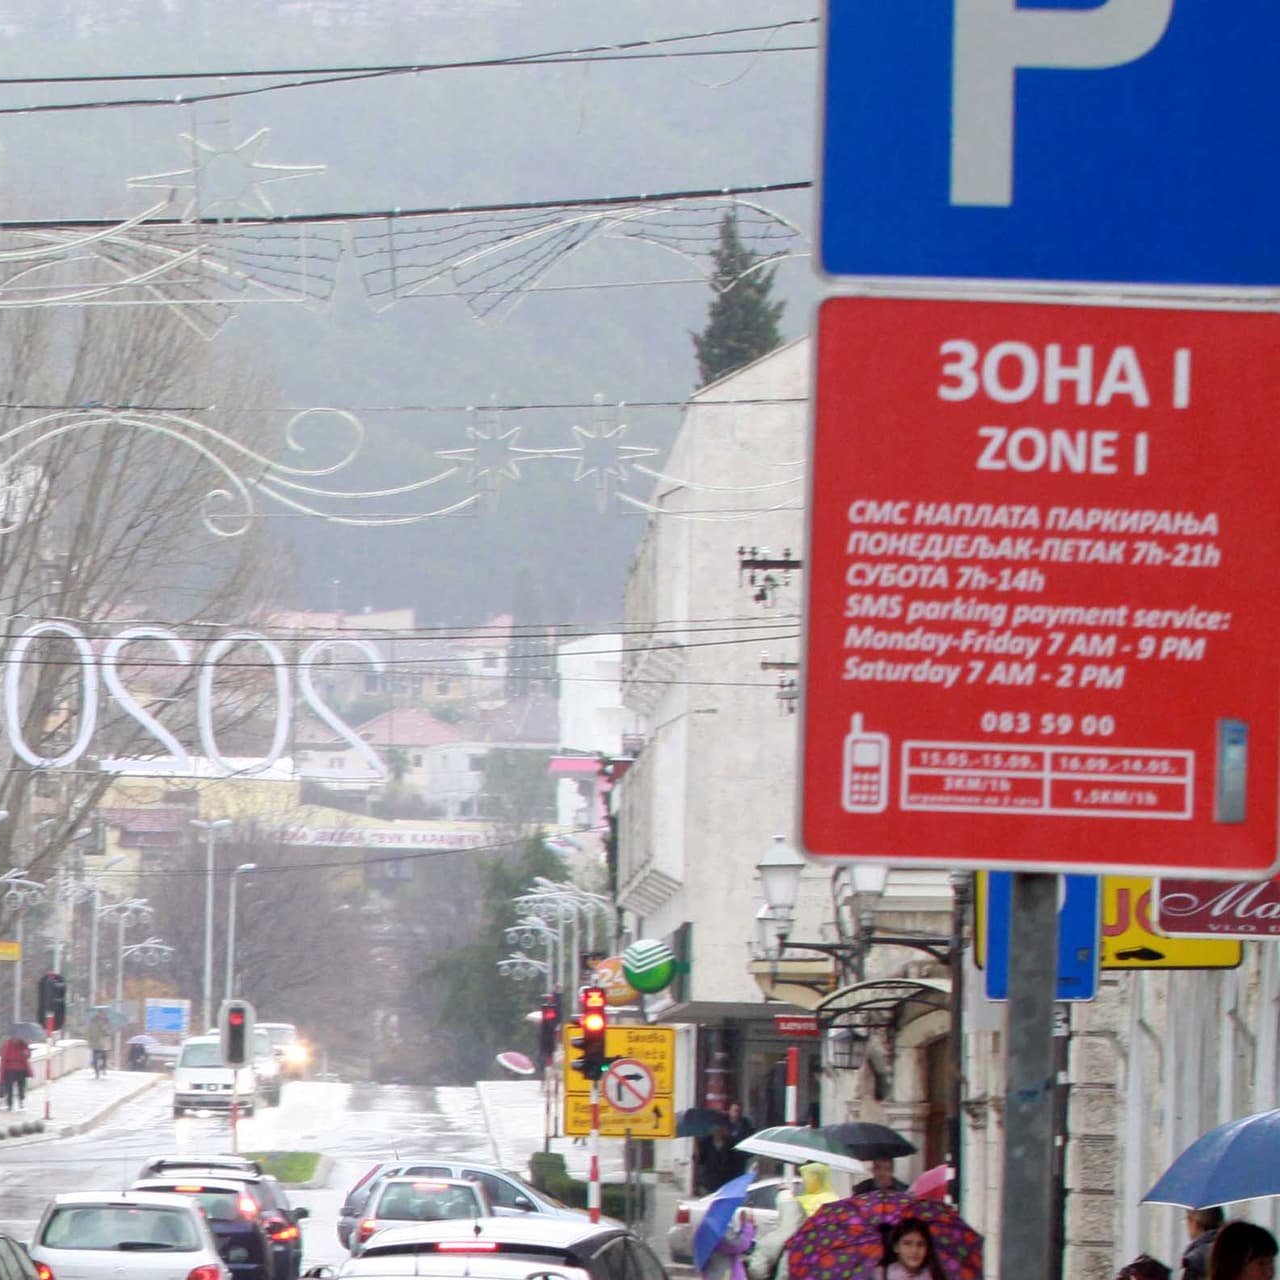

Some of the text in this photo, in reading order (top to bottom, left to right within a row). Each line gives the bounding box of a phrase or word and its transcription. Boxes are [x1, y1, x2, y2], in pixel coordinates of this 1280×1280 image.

[949, 0, 1175, 207] P
[938, 339, 1192, 409] ЗОНА I
[976, 426, 1149, 477] ZONE I
[847, 499, 1220, 536] СМС НАПЛАТА ПАРКИРАЊА
[846, 530, 1222, 568] ПОНЕДЈЕЉАК-ПЕТАК 7h-21h
[845, 562, 1046, 593] СУБОТА 7h-14h
[844, 593, 1232, 631] SMS parking payment service:
[844, 625, 1043, 660] Monday-Friday
[1046, 631, 1066, 656] 7
[1067, 632, 1117, 658] AM
[1135, 634, 1156, 660] 9
[1159, 636, 1207, 661] PM
[843, 655, 962, 689] Saturday
[966, 660, 985, 684] 7
[987, 661, 1037, 686] AM
[1055, 663, 1076, 688] 2
[1078, 664, 1127, 689] PM
[980, 711, 1116, 737] 083 59 00
